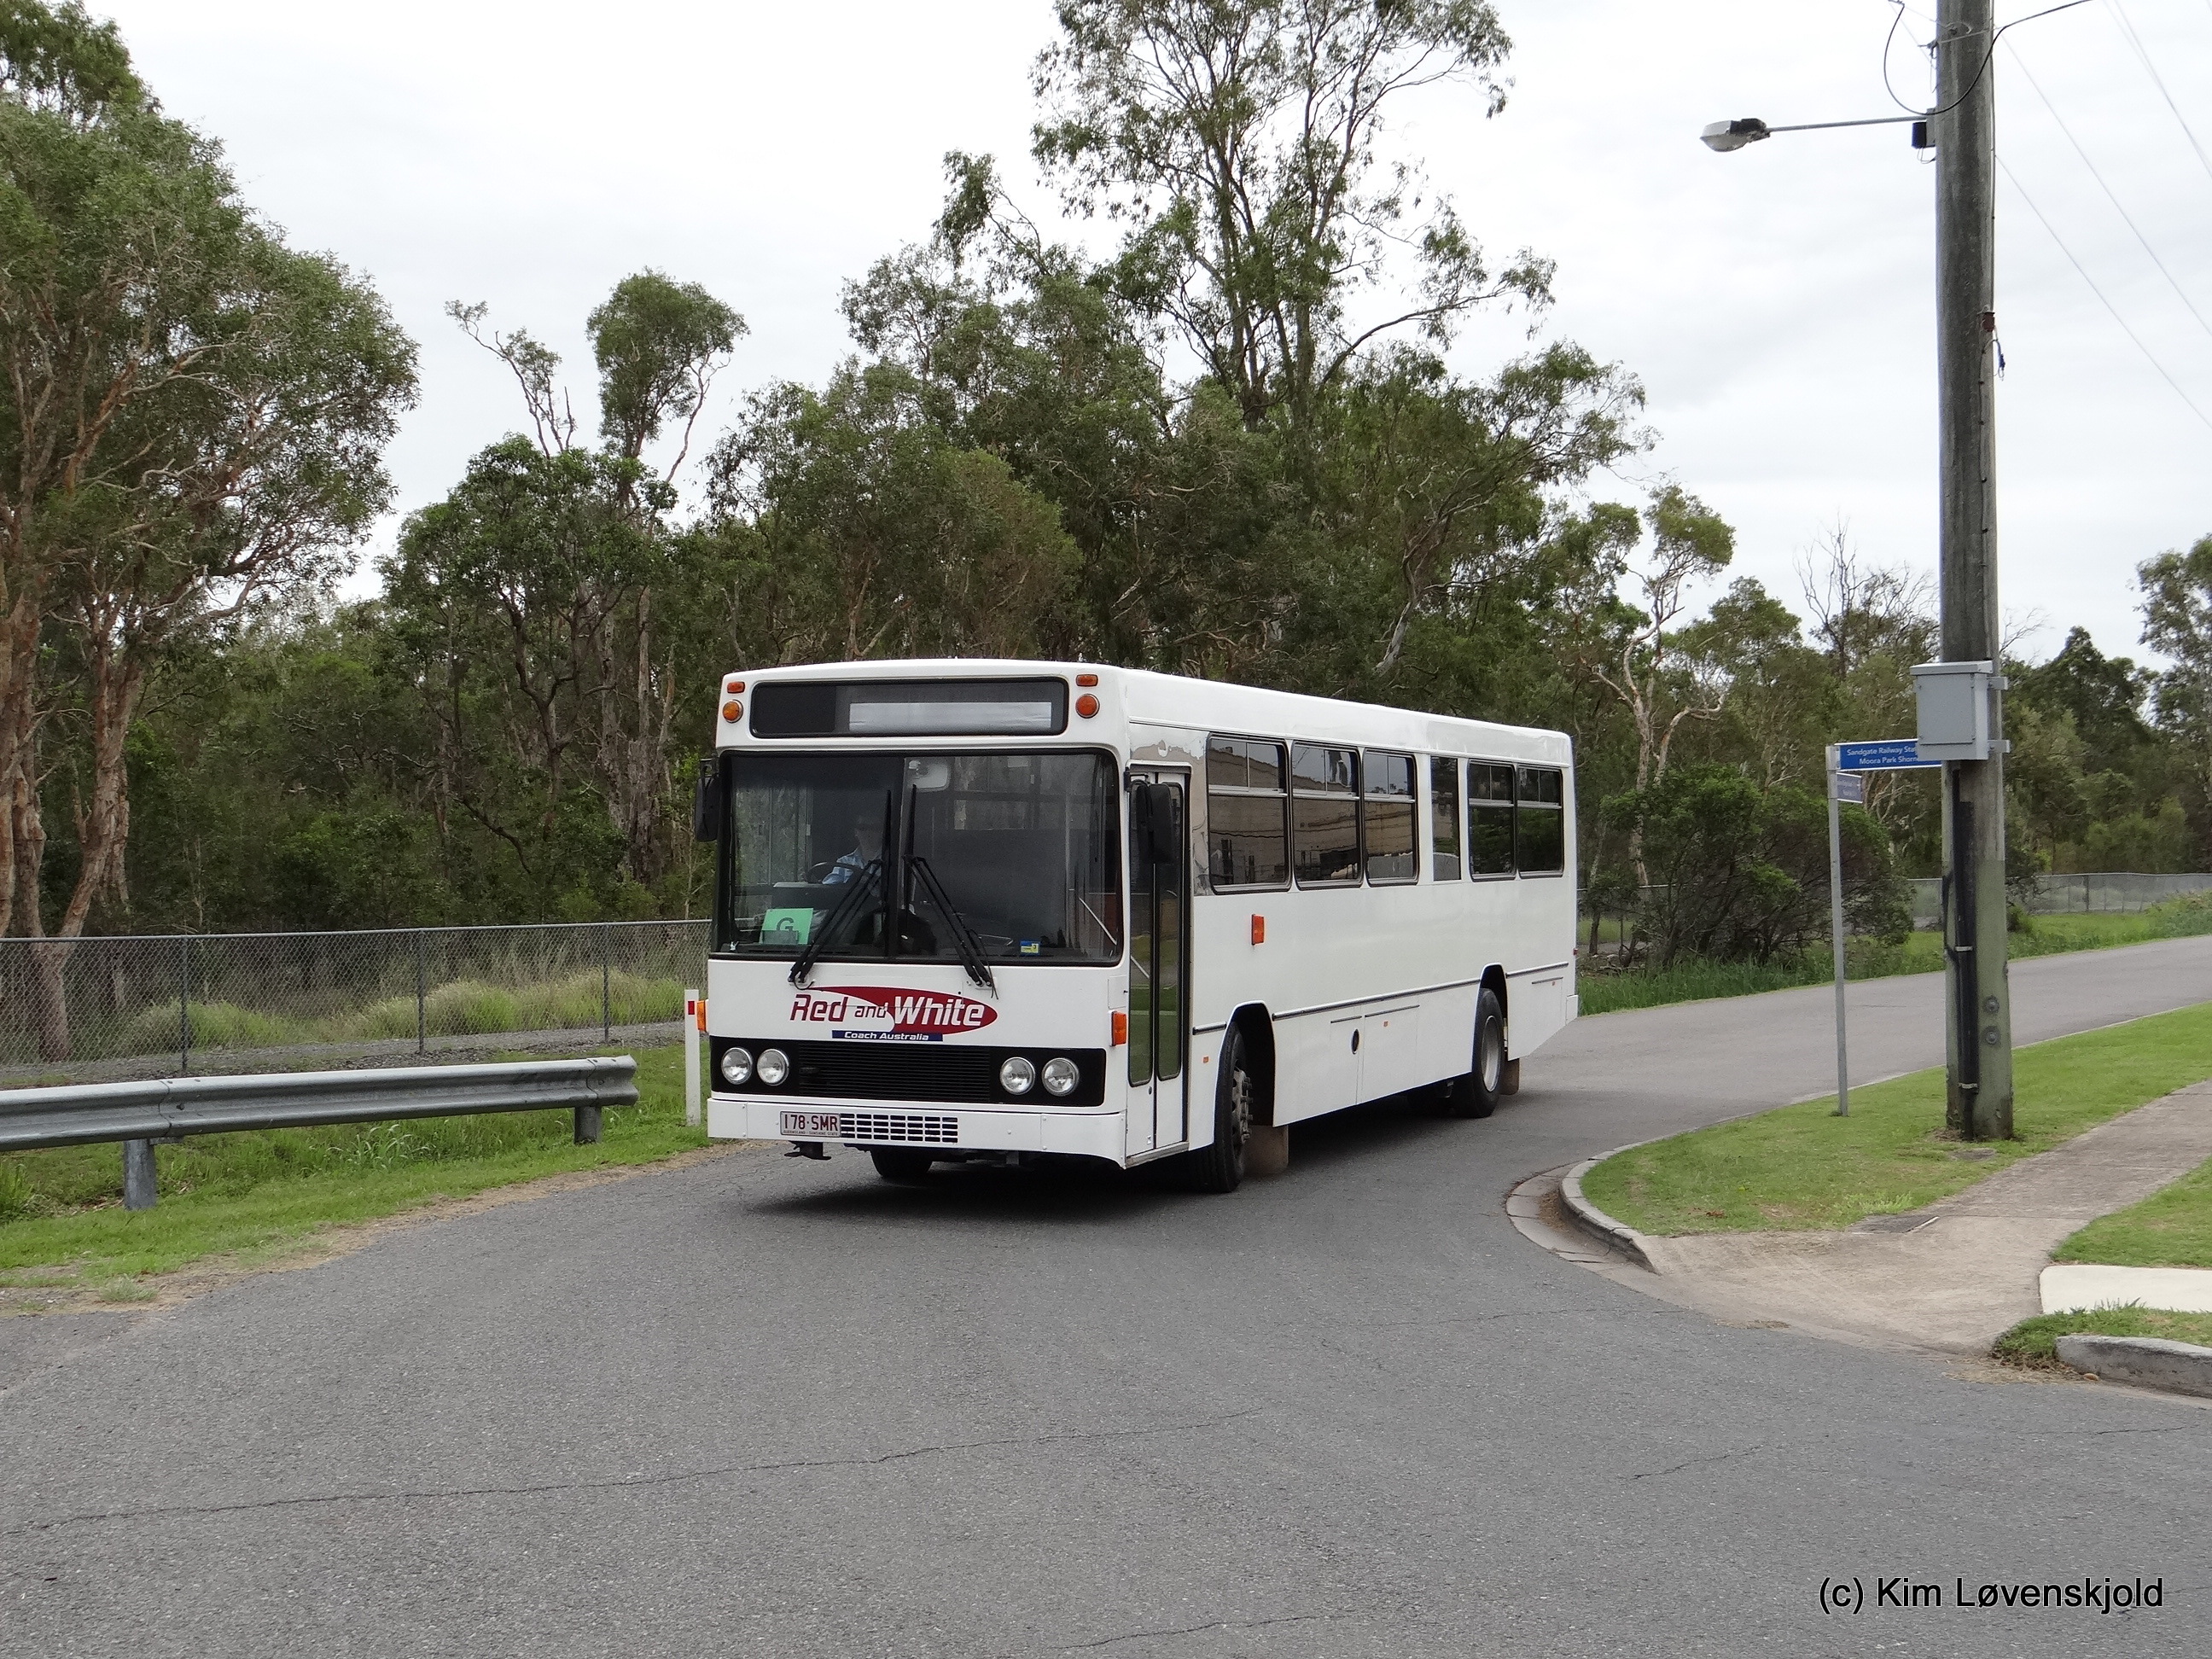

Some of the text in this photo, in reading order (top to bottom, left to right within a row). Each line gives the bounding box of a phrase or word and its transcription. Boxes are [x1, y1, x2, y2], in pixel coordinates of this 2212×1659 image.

[790, 993, 985, 1027] Red and White
[844, 1031, 929, 1041] Coach Australia
